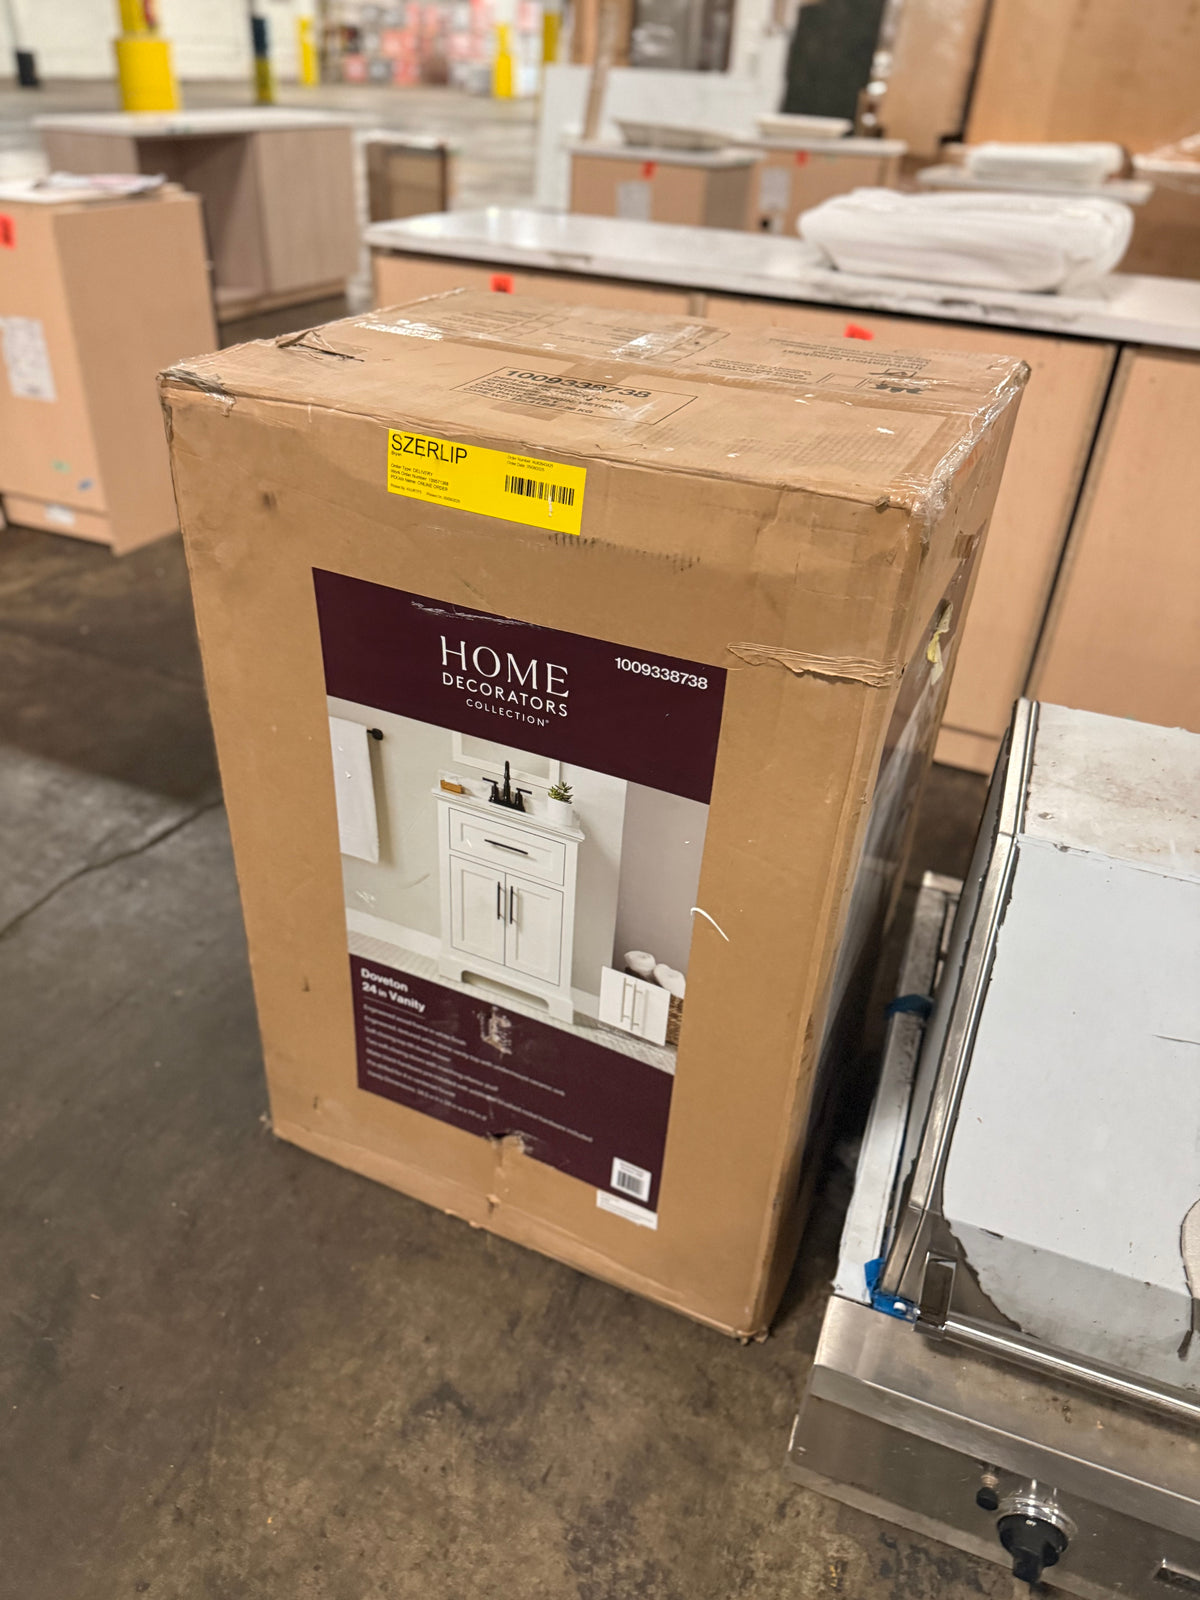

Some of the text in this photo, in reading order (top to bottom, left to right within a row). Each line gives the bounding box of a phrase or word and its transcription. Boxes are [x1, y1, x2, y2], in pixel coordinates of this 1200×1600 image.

[505, 370, 652, 398] 1009338738
[391, 433, 467, 464] SZERLIP
[440, 635, 569, 698] HOME
[615, 656, 709, 691] 1009338738
[442, 672, 569, 718] DECORATORS
[360, 967, 409, 993] Doveton
[362, 981, 426, 1013] 24 in Vanity
